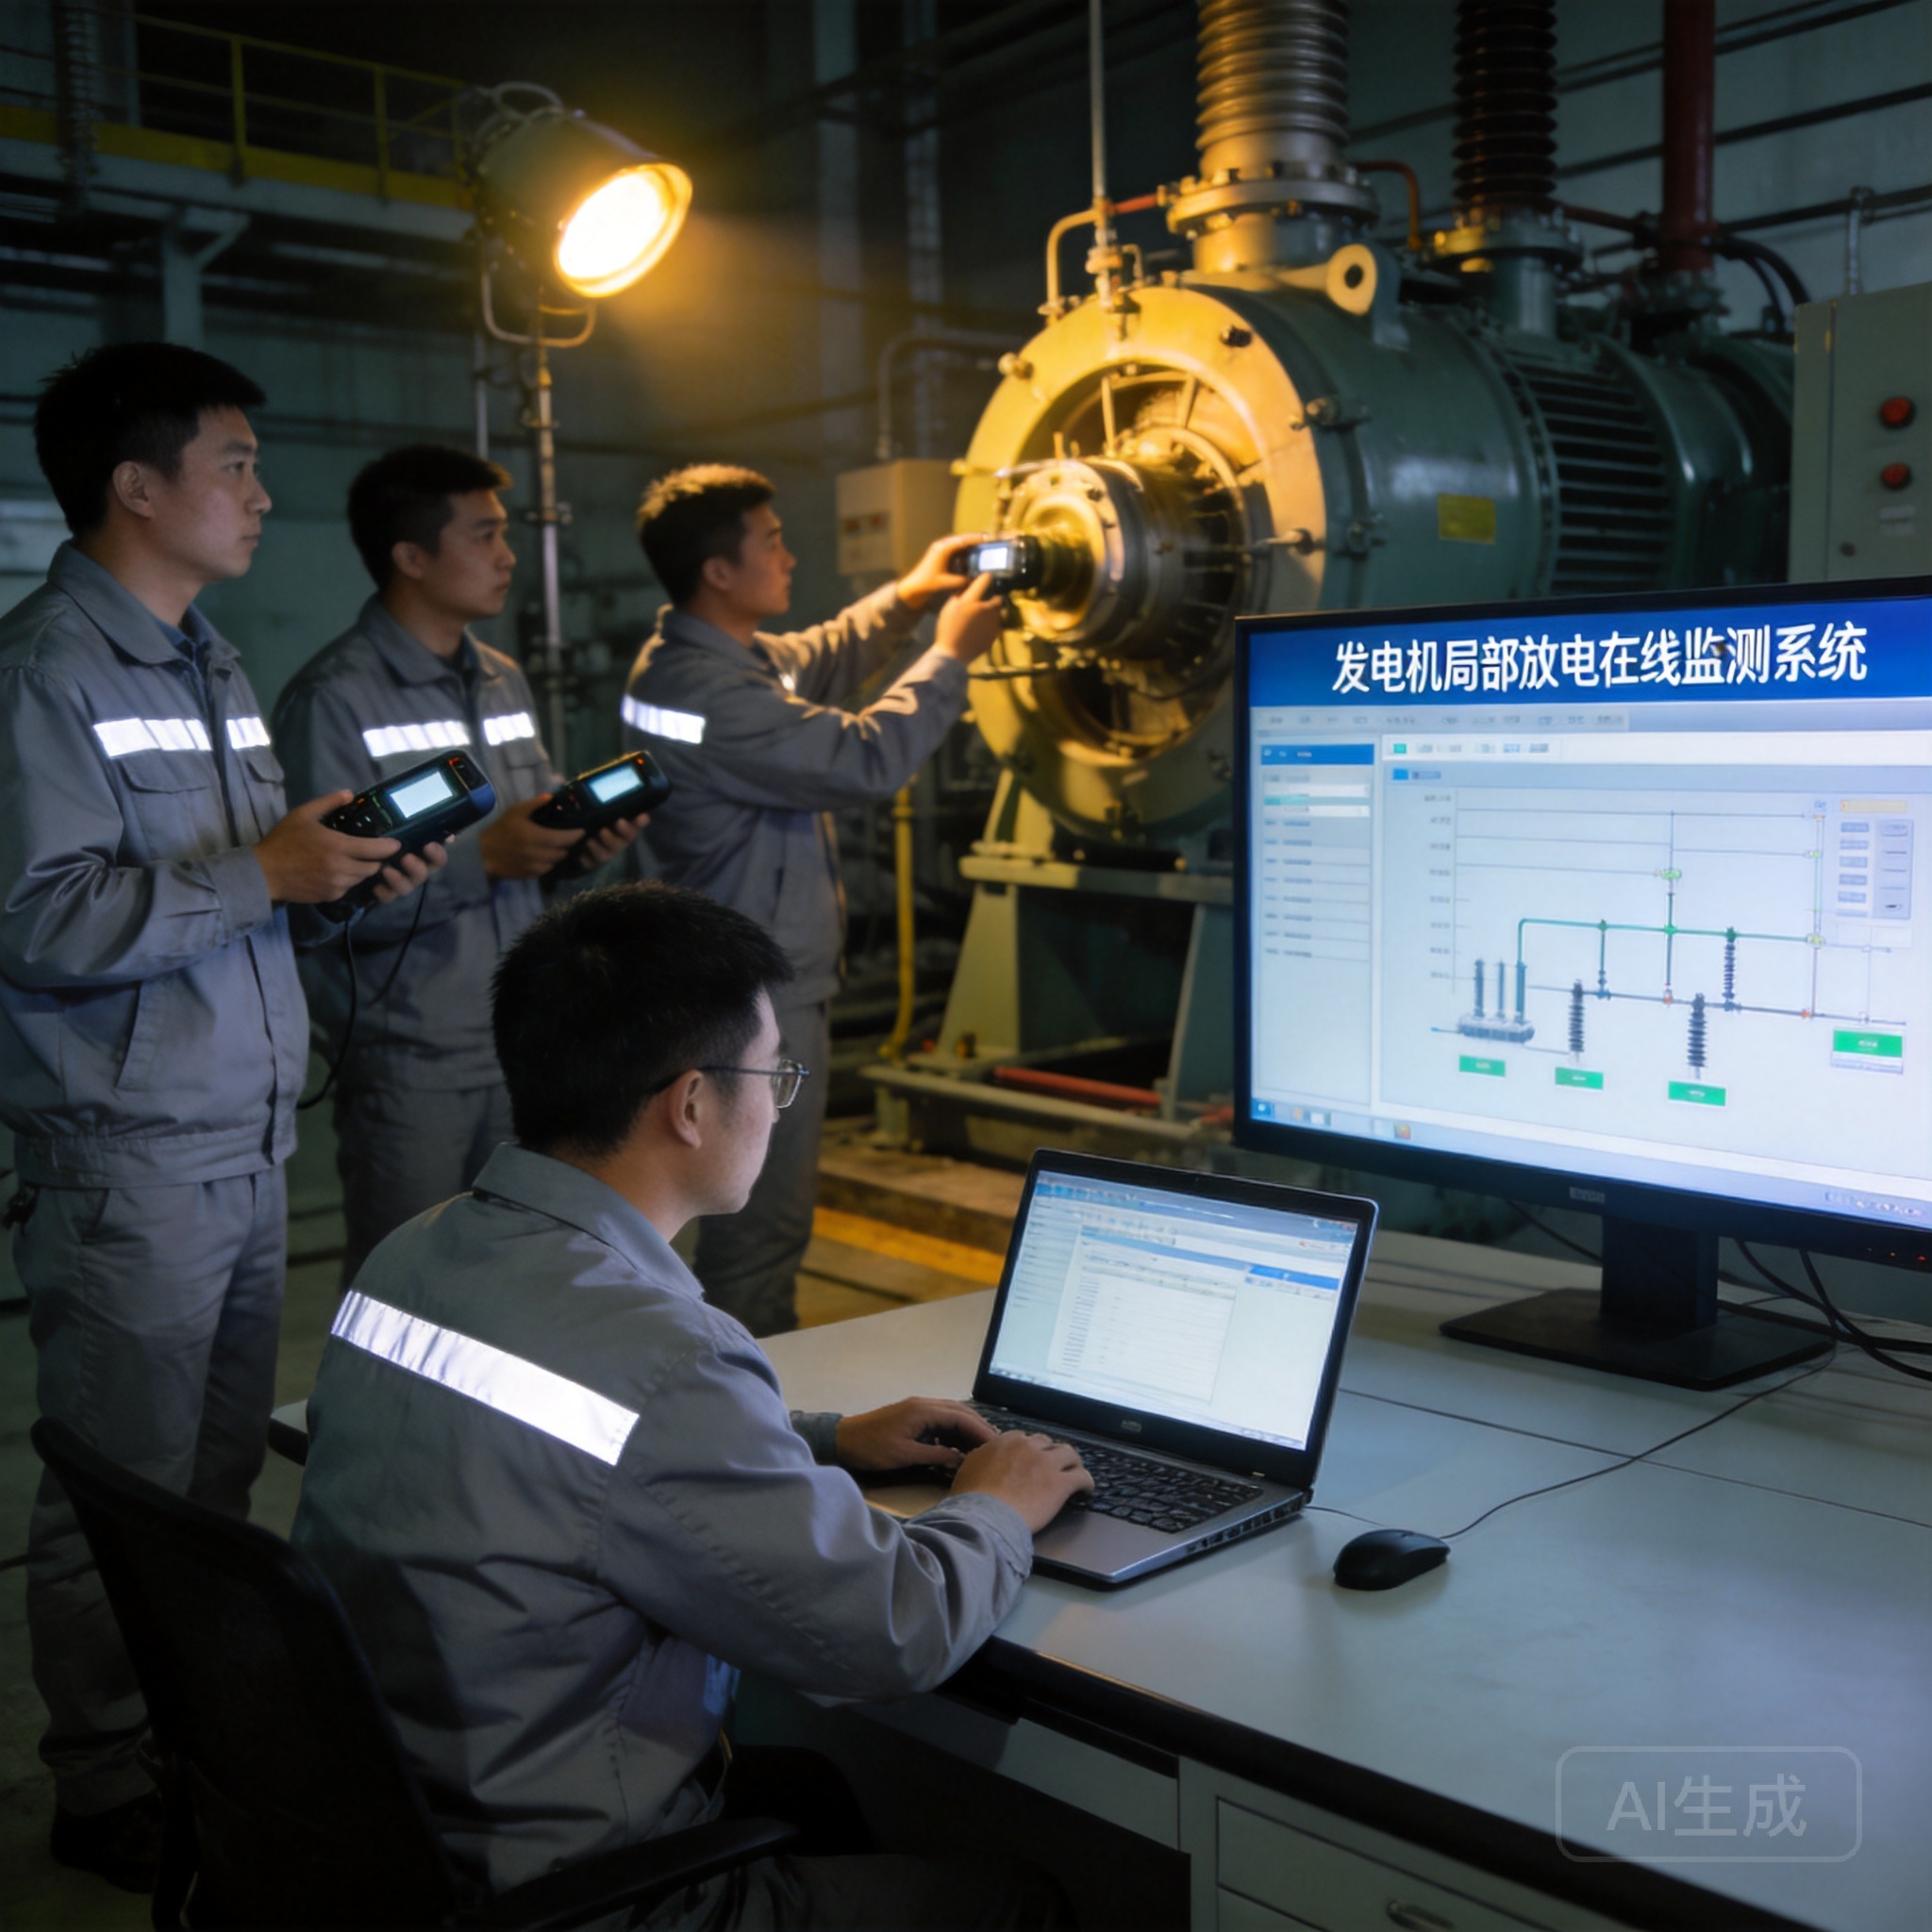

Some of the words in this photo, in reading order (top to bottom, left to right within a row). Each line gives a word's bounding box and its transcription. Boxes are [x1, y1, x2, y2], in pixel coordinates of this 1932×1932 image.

[1332, 621, 1868, 693] 发电机局部放电在线监测系统
